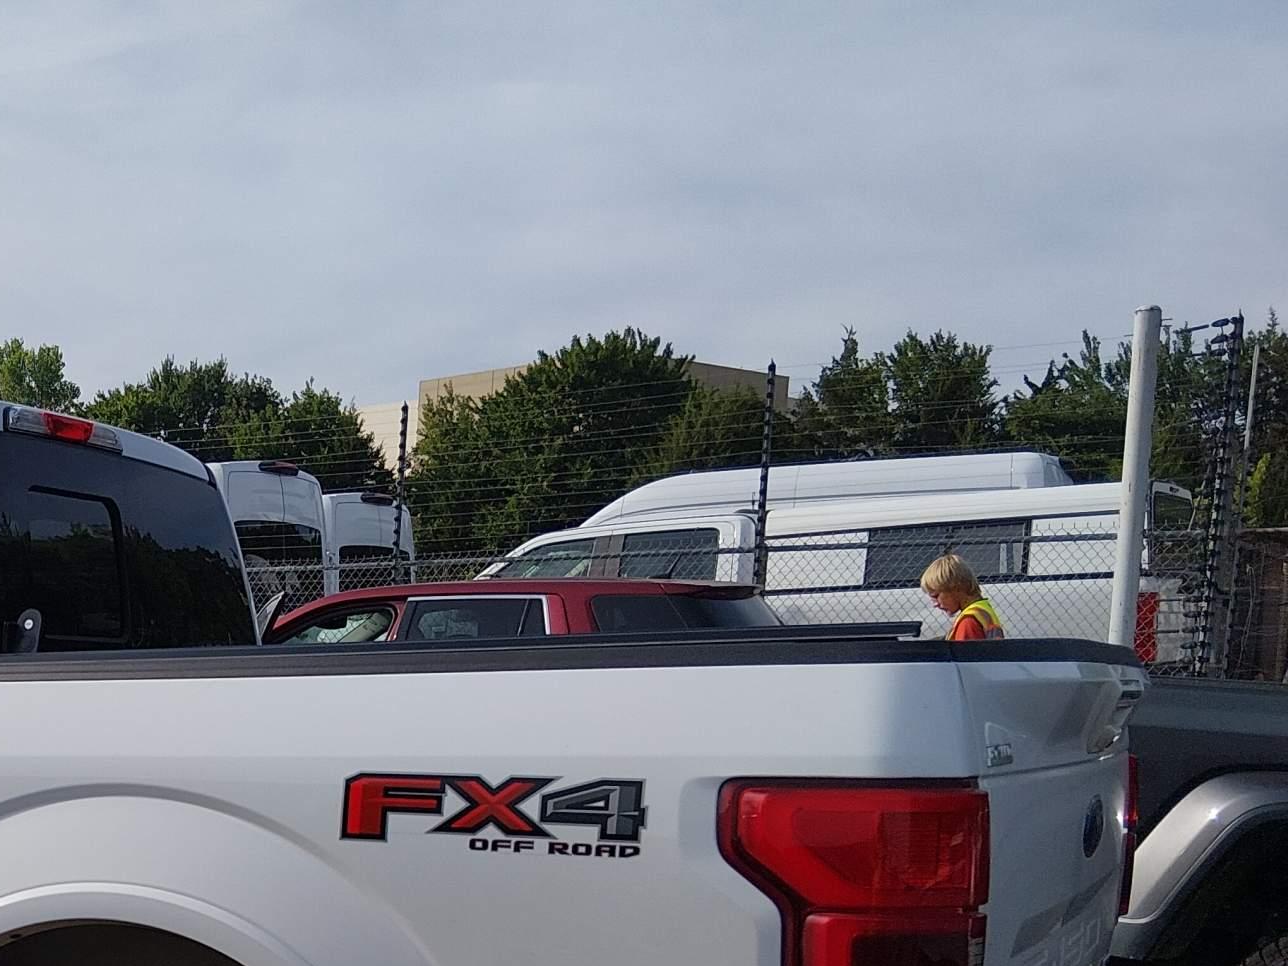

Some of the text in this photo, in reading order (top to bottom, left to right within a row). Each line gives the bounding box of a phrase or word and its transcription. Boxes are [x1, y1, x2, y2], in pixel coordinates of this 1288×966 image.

[339, 771, 648, 843] FX4
[468, 837, 641, 858] OFF ROAD
